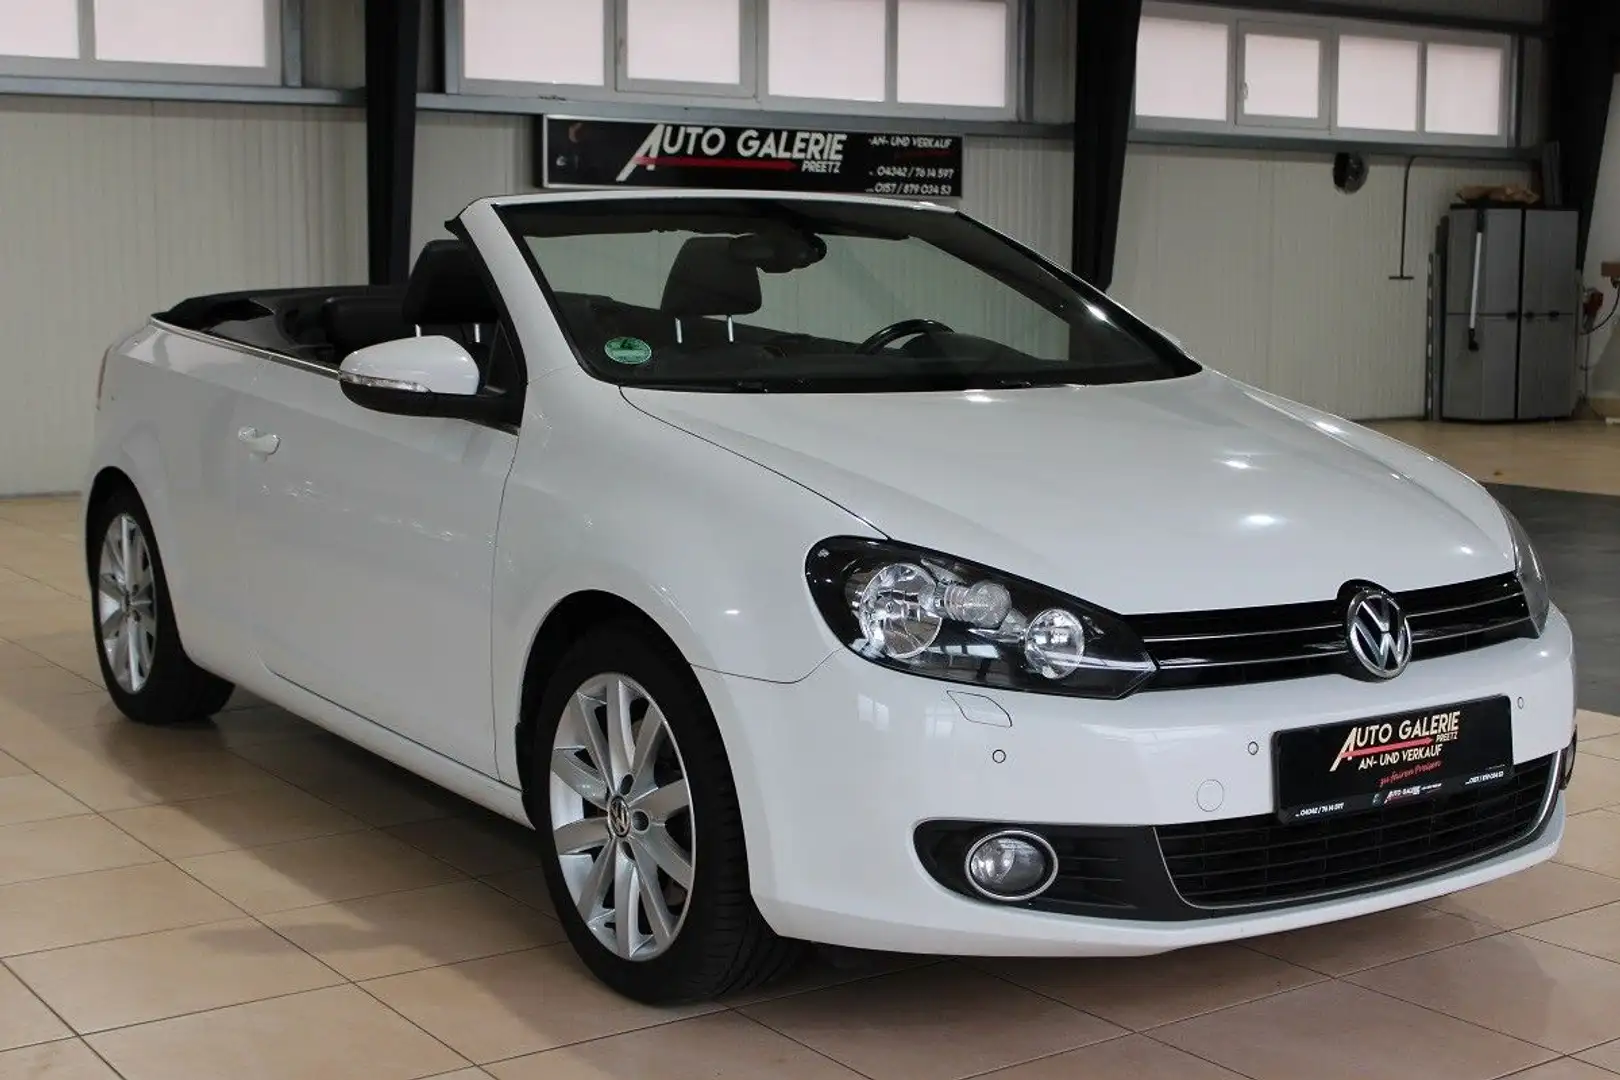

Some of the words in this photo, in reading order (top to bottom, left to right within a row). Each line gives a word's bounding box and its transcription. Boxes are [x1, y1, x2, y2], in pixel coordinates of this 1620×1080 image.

[616, 123, 726, 182] AUTO
[736, 129, 848, 161] GALERIE
[890, 136, 911, 147] UND
[912, 137, 953, 149] VERKAUF
[801, 160, 842, 174] PREETZ
[1329, 724, 1393, 772] AUTO
[1399, 710, 1460, 740] GALERIE
[1435, 731, 1459, 742] PREETZ
[1358, 755, 1377, 770] AN-
[1379, 752, 1400, 766] UND
[1402, 744, 1443, 762] VERKAUF
